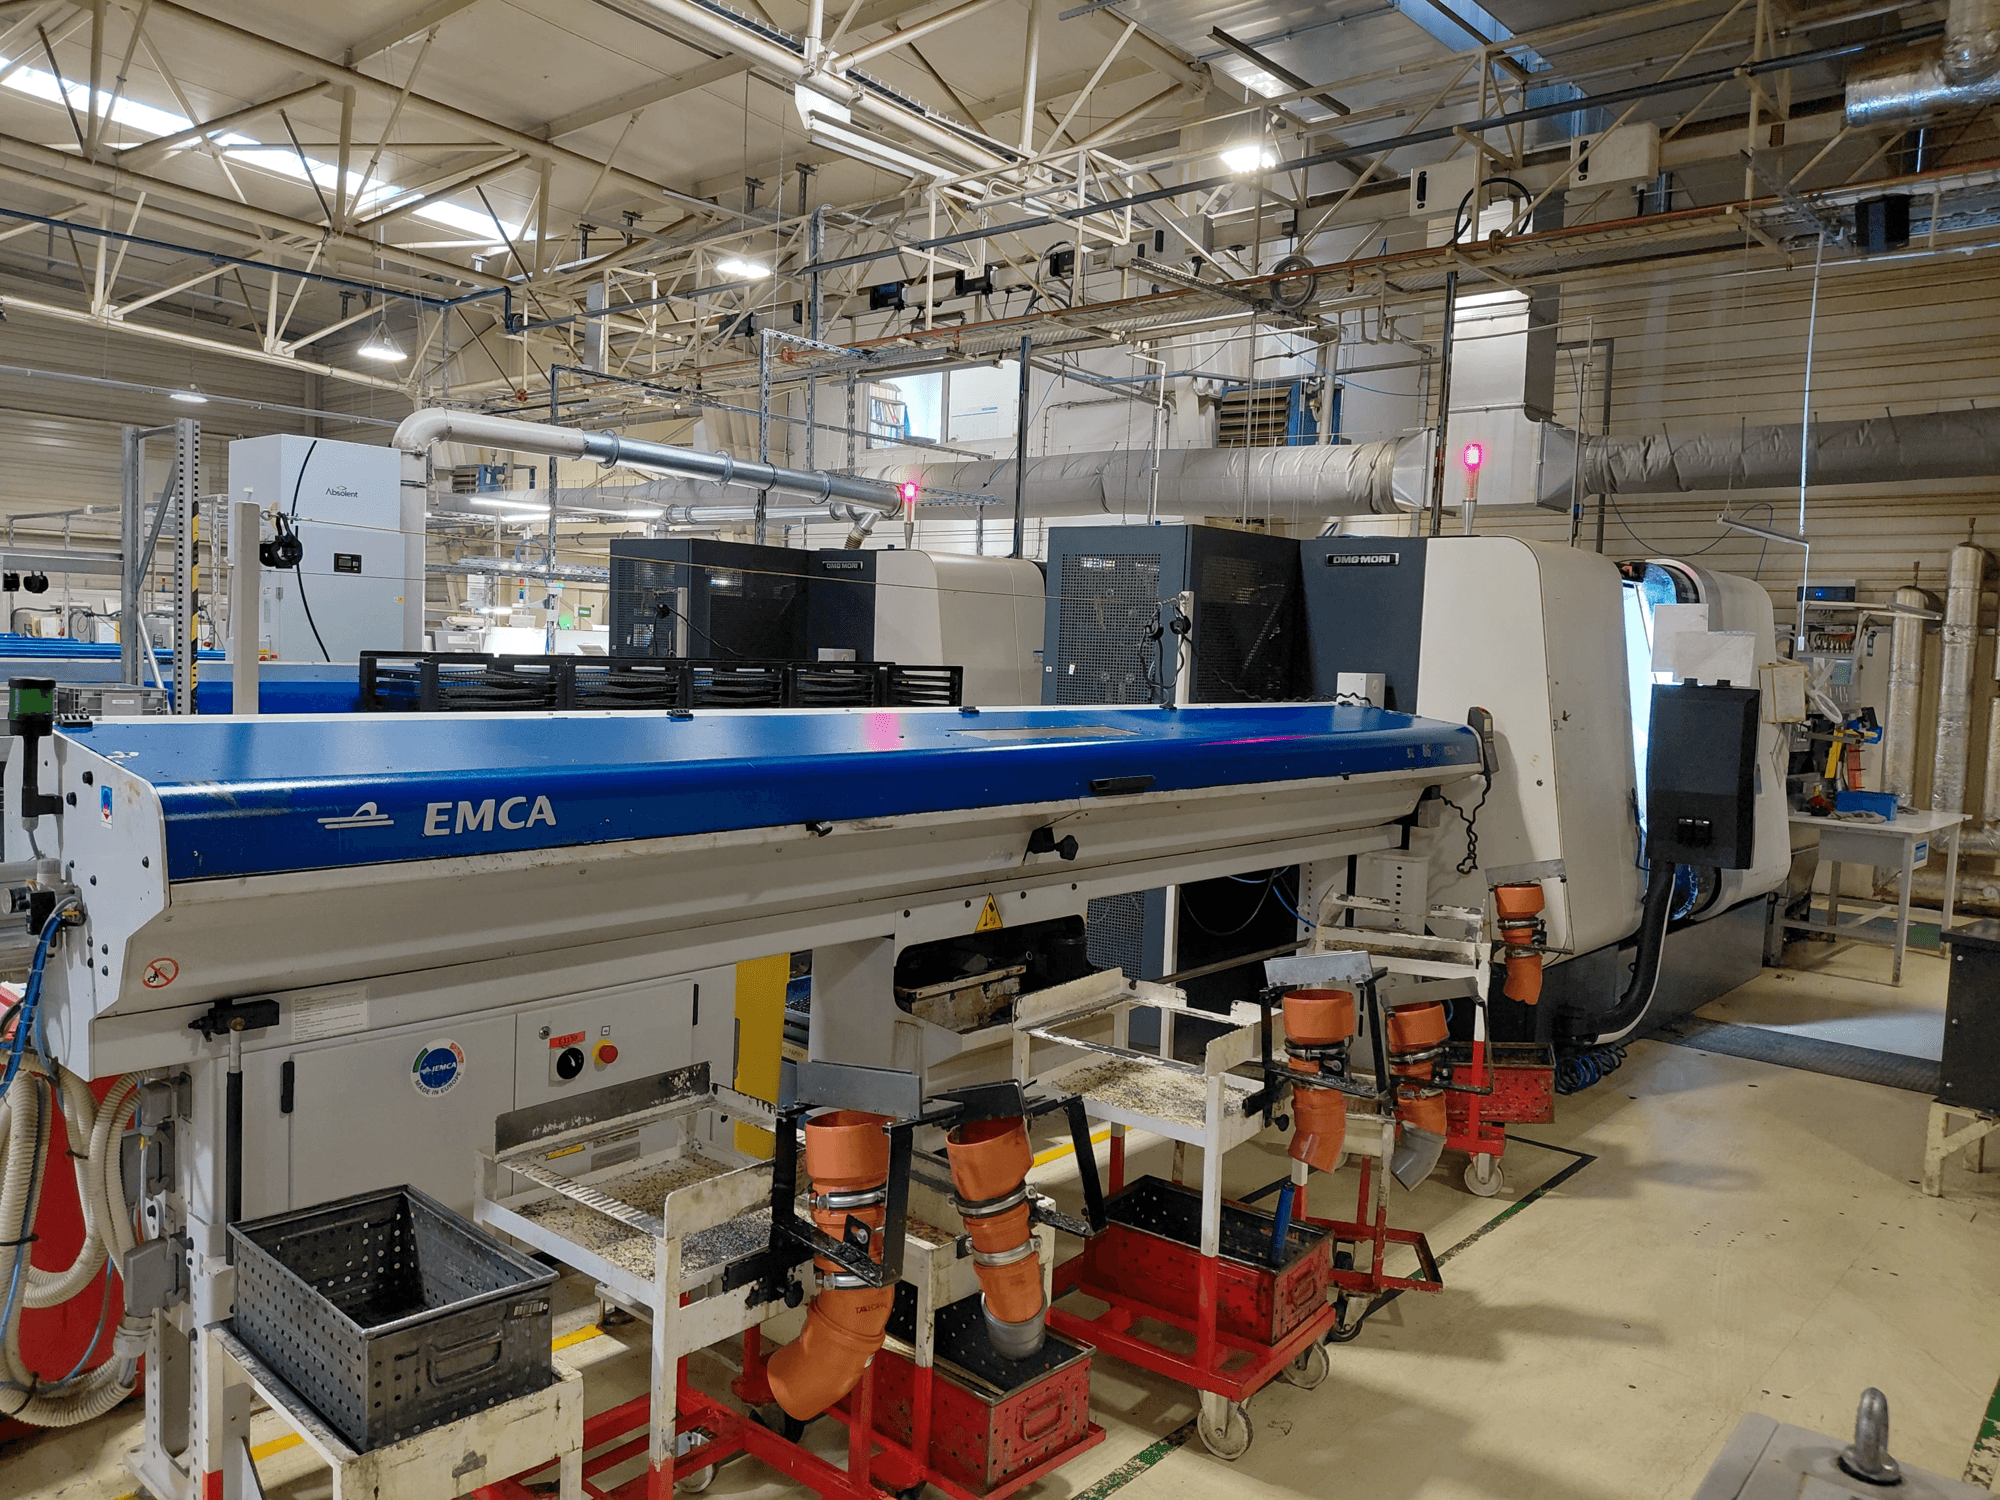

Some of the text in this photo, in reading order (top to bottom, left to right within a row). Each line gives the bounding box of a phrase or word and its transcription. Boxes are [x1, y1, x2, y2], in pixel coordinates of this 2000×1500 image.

[325, 487, 358, 498] Absolent
[1333, 555, 1391, 564] DMG MORI
[424, 795, 557, 836] EMCA
[432, 1062, 457, 1072] IEMCA
[414, 1079, 430, 1095] MADE
[440, 1071, 462, 1094] EUROPE
